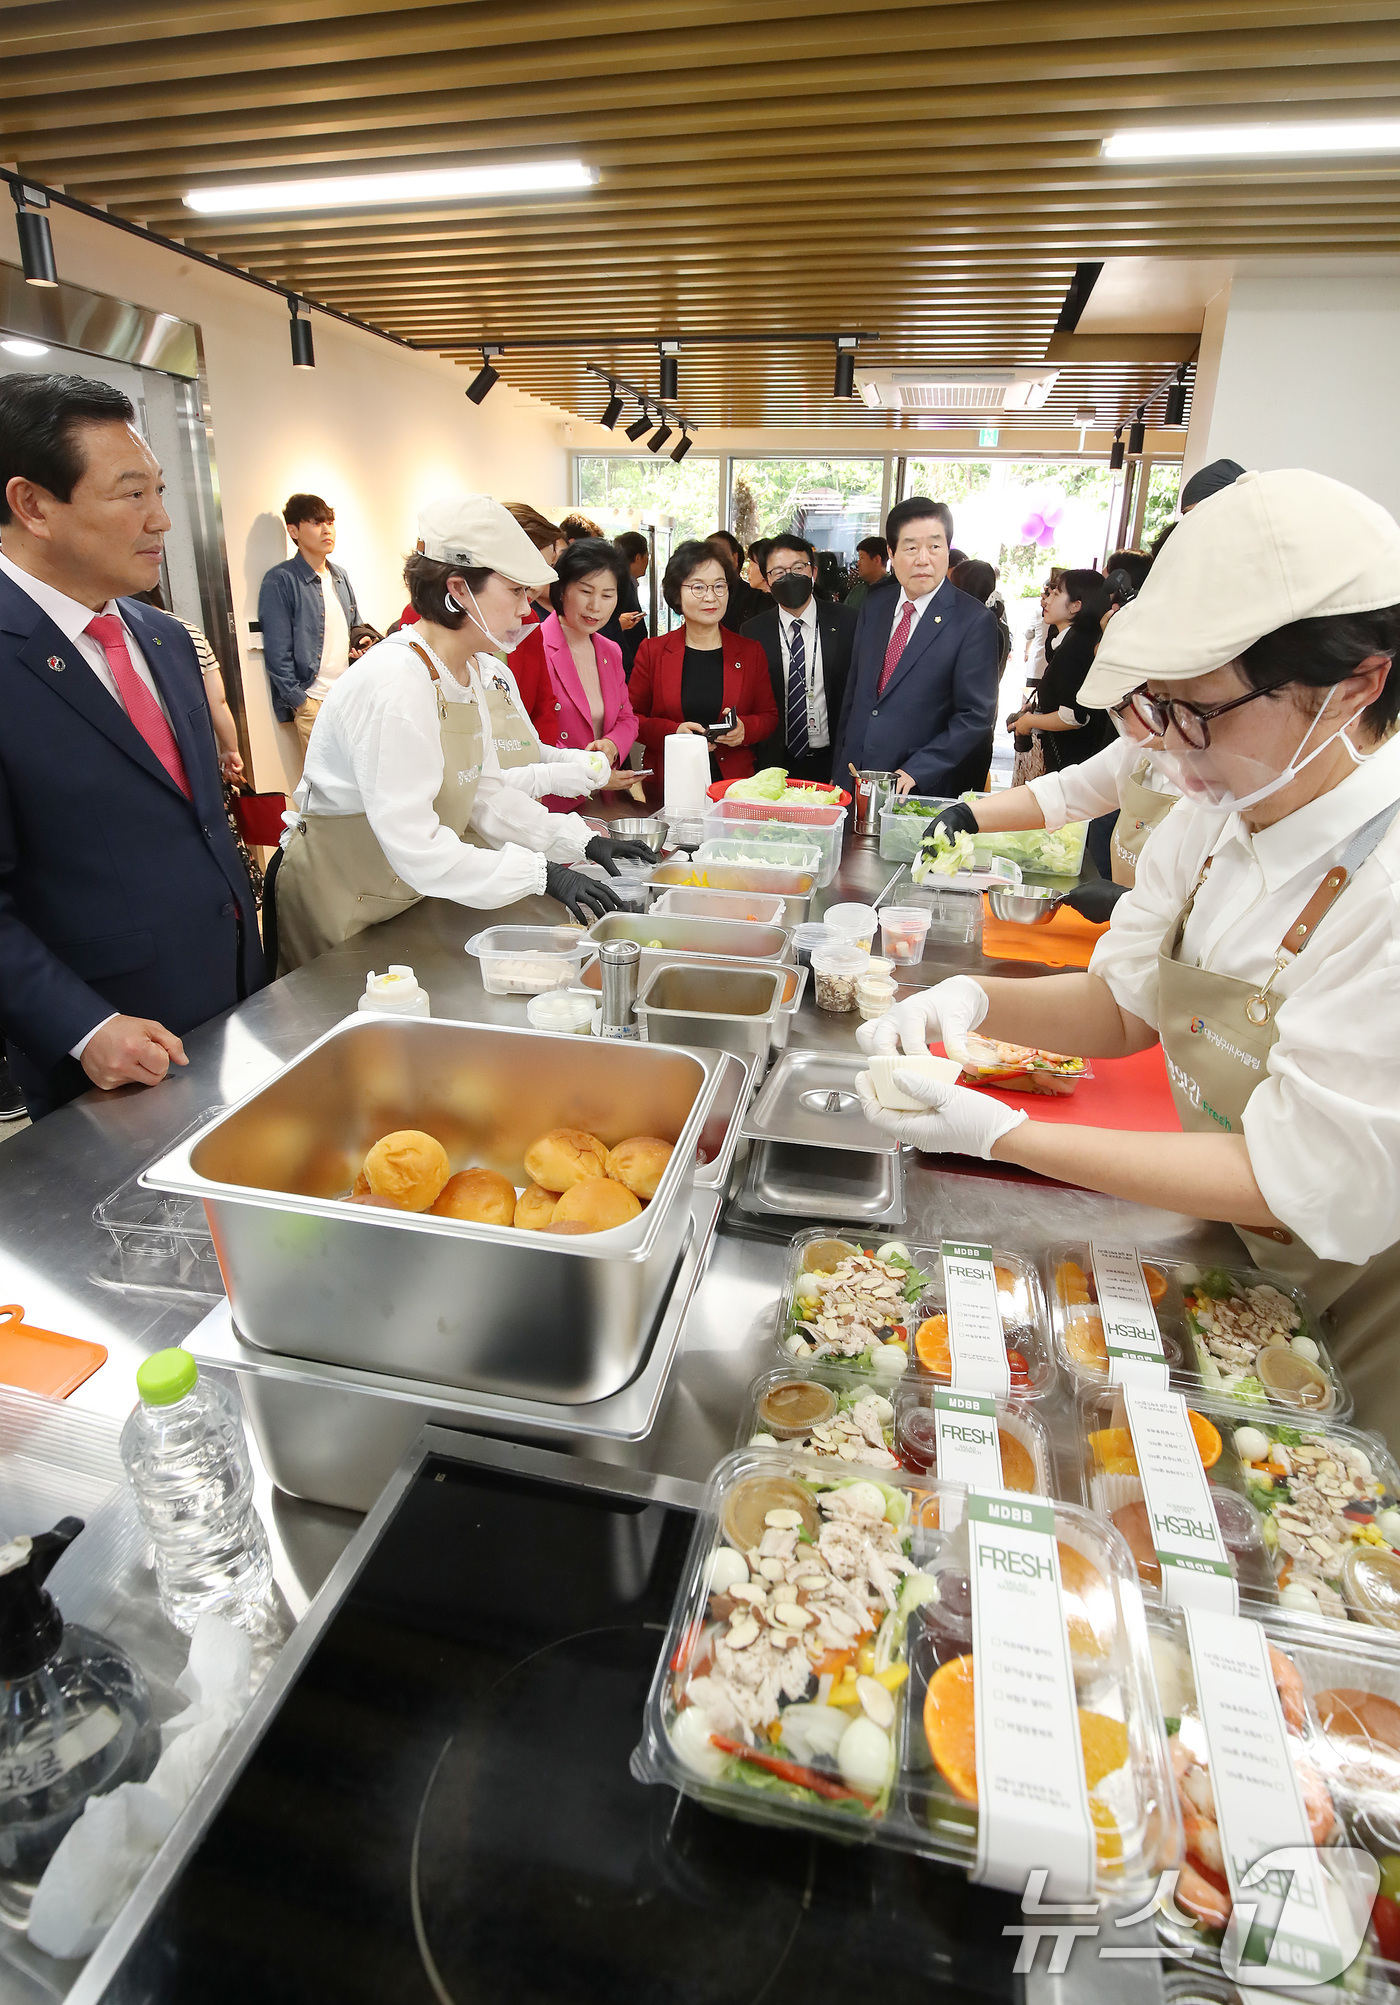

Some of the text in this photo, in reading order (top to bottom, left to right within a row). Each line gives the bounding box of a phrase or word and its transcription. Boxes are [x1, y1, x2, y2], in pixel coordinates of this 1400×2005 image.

[1202, 1100, 1232, 1132] Fresh
[953, 1247, 980, 1257] MDBB
[949, 1265, 992, 1281] FRESH
[1108, 1322, 1156, 1342] FRESH
[948, 1397, 980, 1411] MDBB
[941, 1424, 994, 1446] FRESH
[988, 1503, 1033, 1524] MDBB
[1154, 1513, 1216, 1541] FRESH
[978, 1545, 1054, 1582] FRESH
